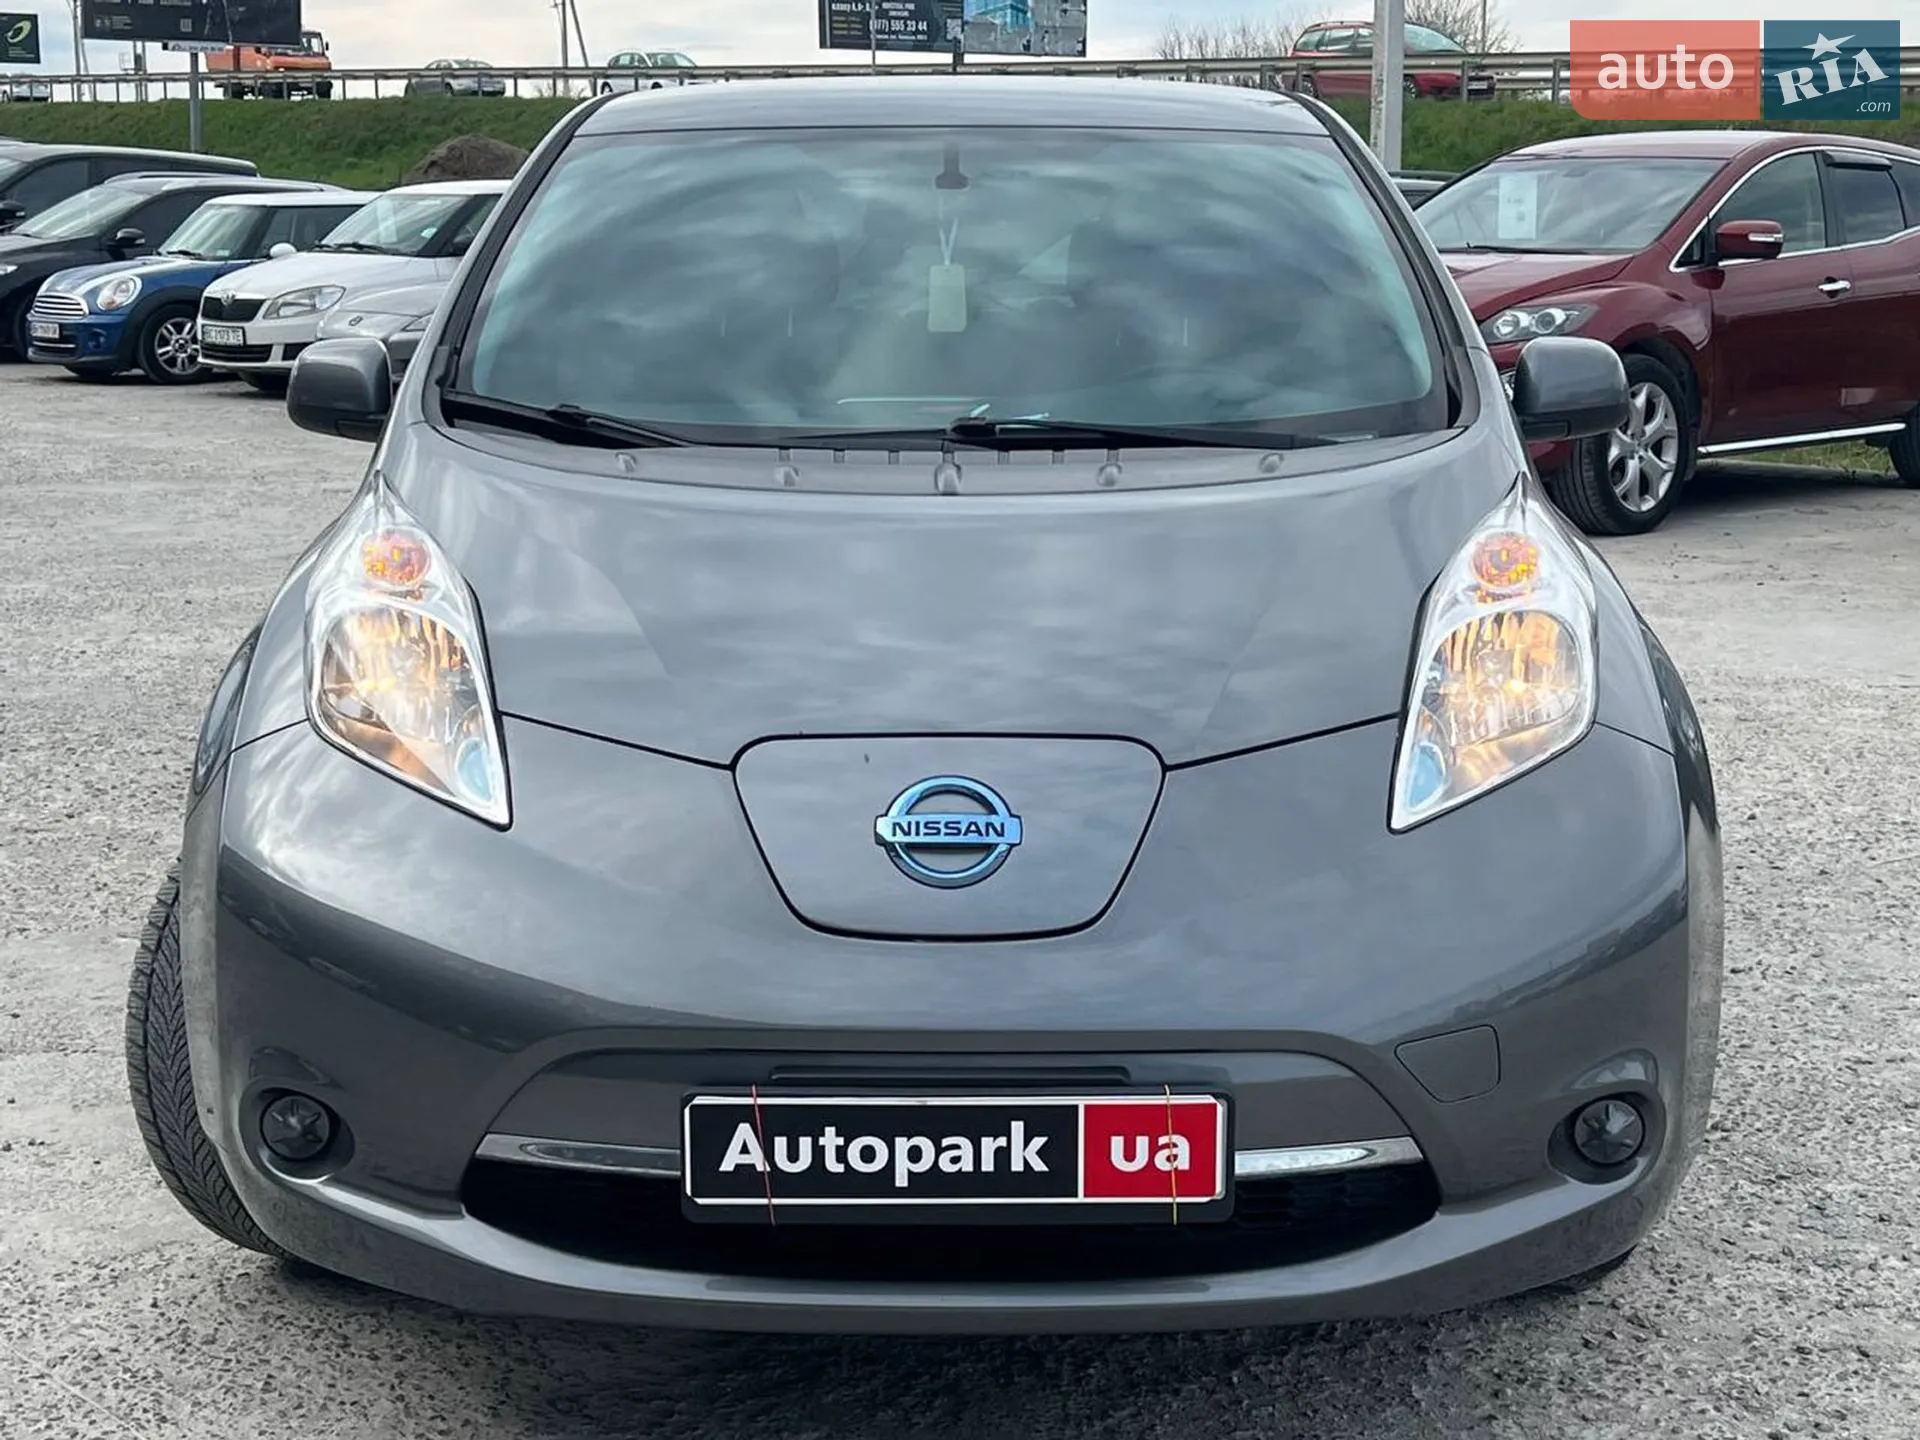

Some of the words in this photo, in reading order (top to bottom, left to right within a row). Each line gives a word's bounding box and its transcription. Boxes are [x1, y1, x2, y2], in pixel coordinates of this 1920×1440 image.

[891, 820, 1005, 838] NISSAN
[719, 1120, 1050, 1188] Autopark
[1110, 1134, 1191, 1172] ua
